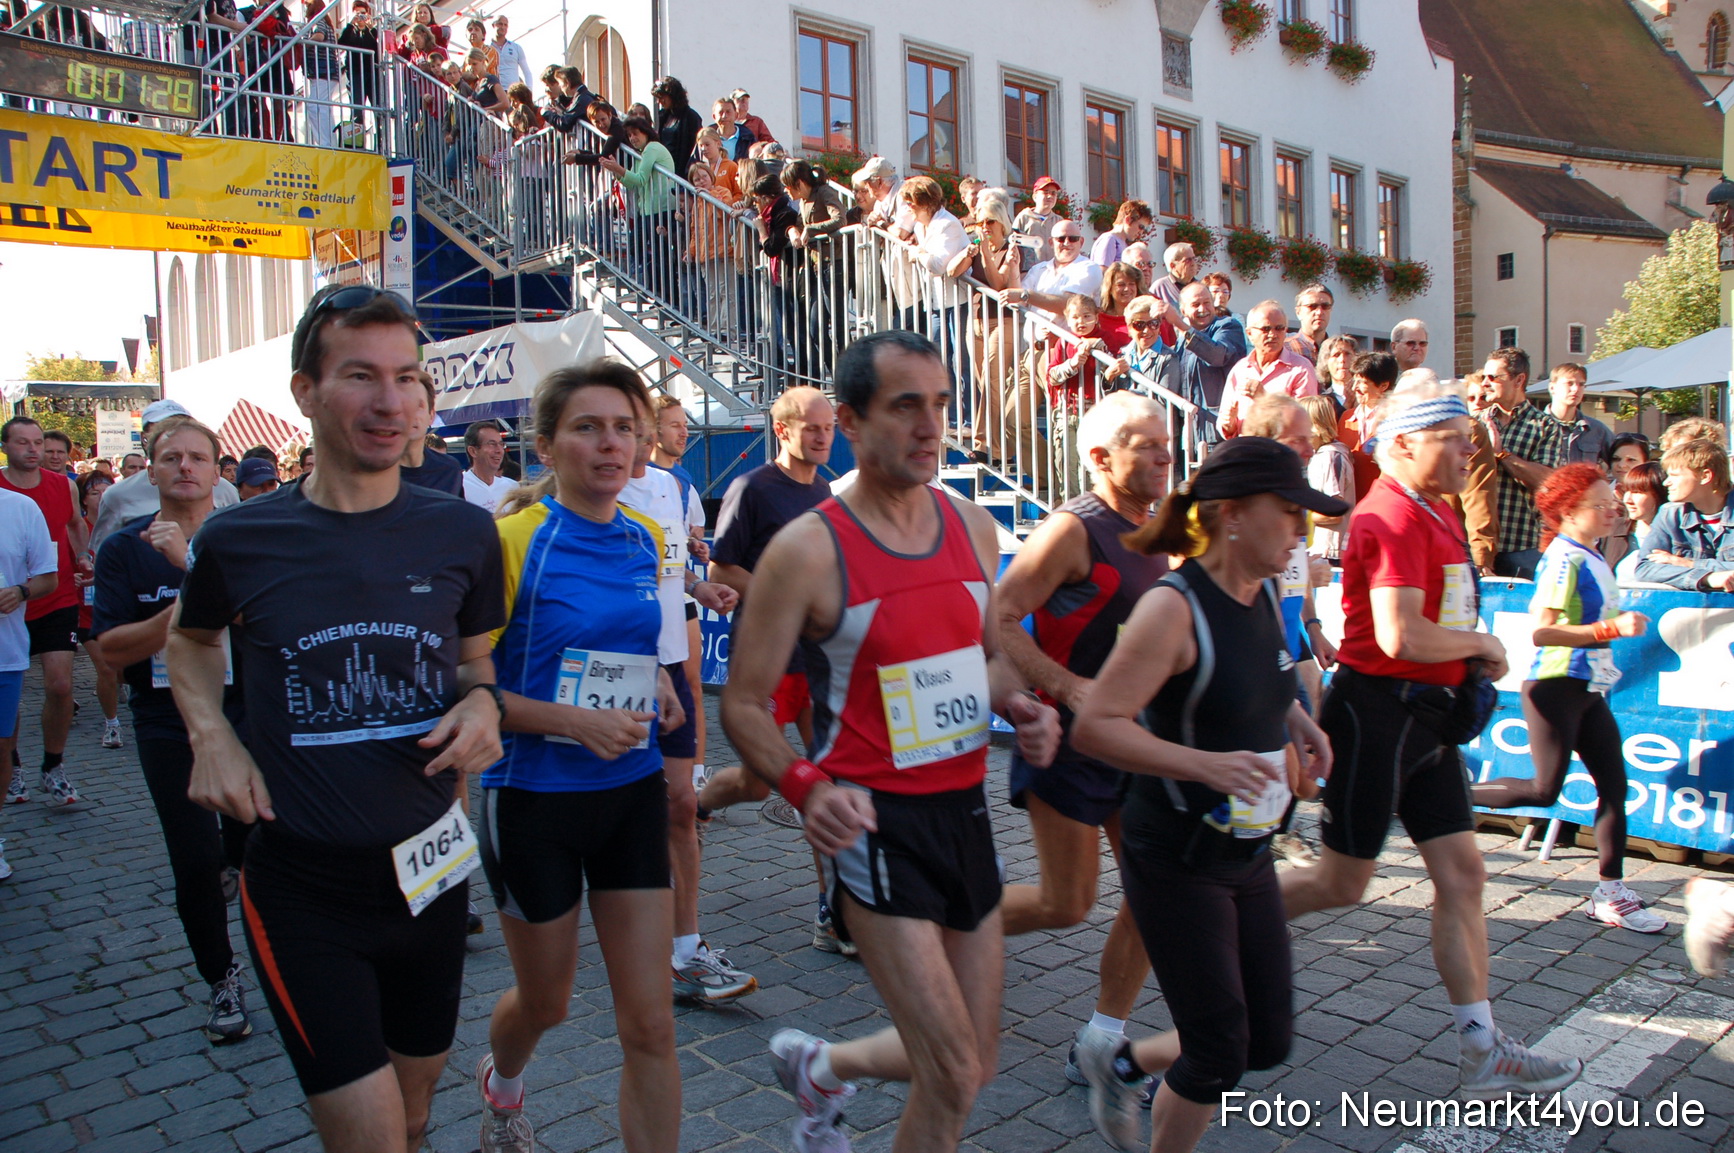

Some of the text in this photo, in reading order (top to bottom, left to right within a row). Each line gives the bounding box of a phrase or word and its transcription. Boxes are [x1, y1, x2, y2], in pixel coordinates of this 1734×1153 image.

[20, 40, 83, 59] Elektronische
[225, 184, 356, 205] Neumarkter Stadtlauf
[281, 622, 443, 660] 3. CHIEMGAUER 100
[589, 660, 625, 682] Birgit
[913, 669, 953, 689] Klaus
[934, 694, 979, 729] 509
[406, 818, 464, 877] 1064
